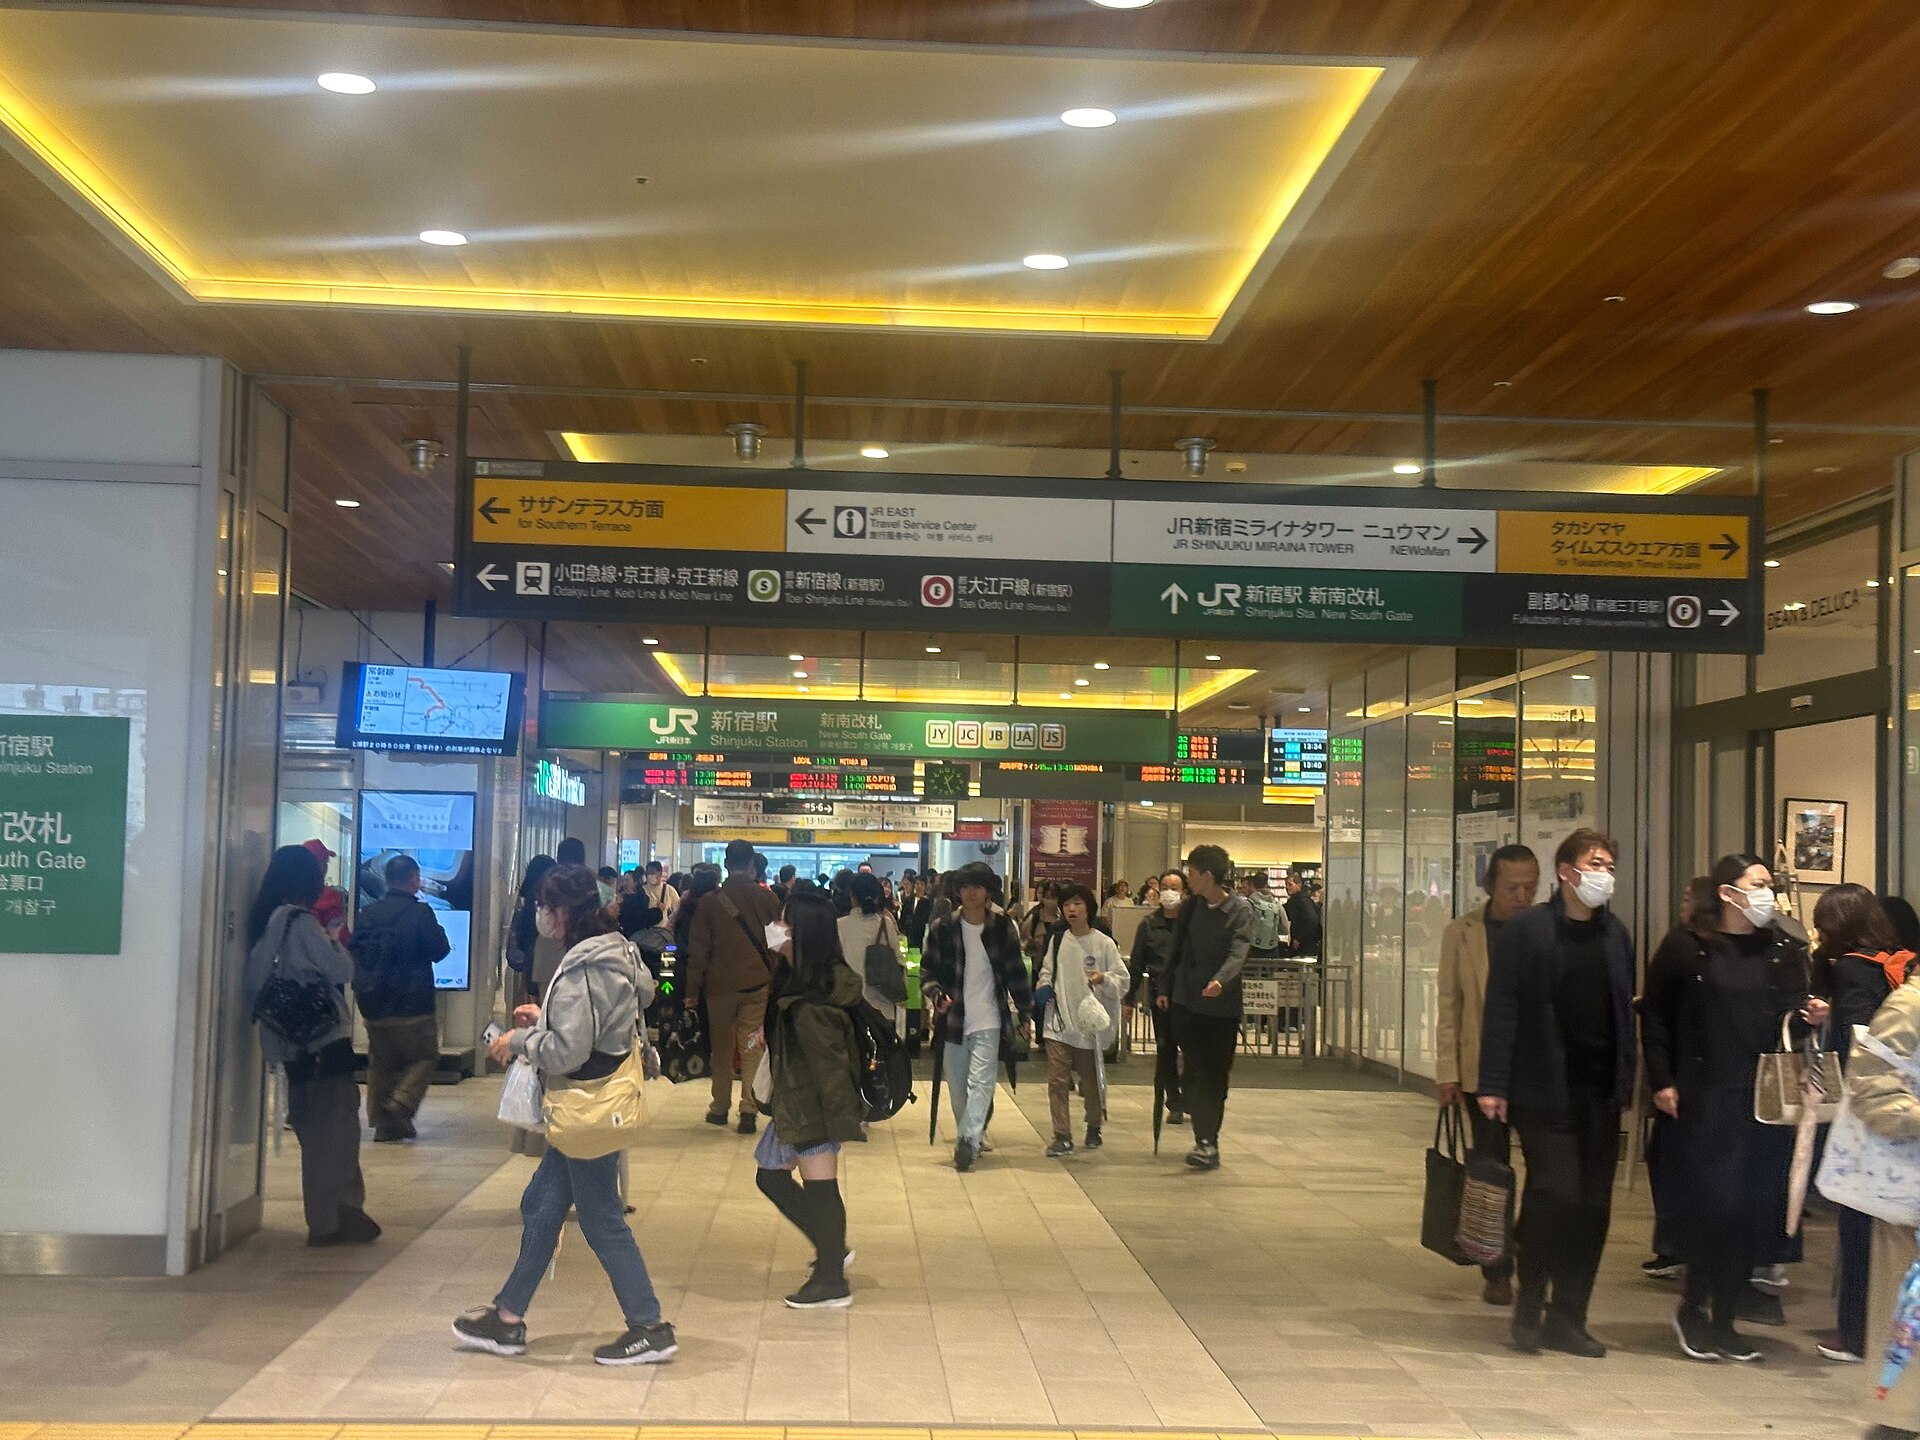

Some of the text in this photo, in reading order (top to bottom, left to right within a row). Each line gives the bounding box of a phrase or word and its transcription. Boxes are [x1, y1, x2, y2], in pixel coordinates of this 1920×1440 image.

[518, 496, 664, 518] サザンテラス方面
[870, 507, 916, 517] JR EAST
[518, 518, 632, 531] for Southern Terrace
[870, 519, 976, 530] Travel Service Center
[1167, 518, 1450, 540] JR新宿ミライナタワー ニュウマン
[1552, 522, 1625, 535] タカシマヤ
[1173, 540, 1450, 556] JR SHINJUKU MIRAINA TOWER NEWoMan
[1551, 540, 1701, 557] タイムズスクエア方面
[759, 580, 768, 591] S
[795, 571, 841, 590] 新宿線
[968, 577, 1030, 596] 大江戸線
[553, 585, 588, 599] Odakyu
[638, 588, 656, 599] Line
[660, 590, 666, 599] &
[692, 590, 711, 601] New
[714, 591, 733, 602] Line
[804, 594, 843, 606] Shinjuku
[845, 595, 865, 606] Line
[1198, 583, 1241, 607] JR
[1245, 584, 1385, 606] 新宿駅 新南改札
[978, 599, 1003, 609] Oedo
[1005, 600, 1024, 610] Line
[1528, 592, 1589, 611] 副都心線
[1810, 588, 1859, 618] DELUCA
[1246, 607, 1293, 620] Shinjuku
[1321, 609, 1347, 620] New
[1350, 609, 1383, 621] South
[1386, 610, 1413, 621] Gate
[649, 708, 698, 735] JR
[711, 710, 777, 732] 新宿駅
[819, 712, 882, 729] 新南改札
[656, 736, 691, 745] JR東日本
[819, 730, 892, 740] New South Gate
[932, 728, 946, 740] JY
[961, 729, 975, 740] JC
[989, 730, 1003, 741] JB
[1016, 731, 1032, 742] JA
[1046, 732, 1059, 743] JS
[711, 735, 808, 749] Shinjuku Station
[46, 762, 93, 774] Station
[0, 811, 71, 844] 改札
[36, 850, 87, 869] Gate
